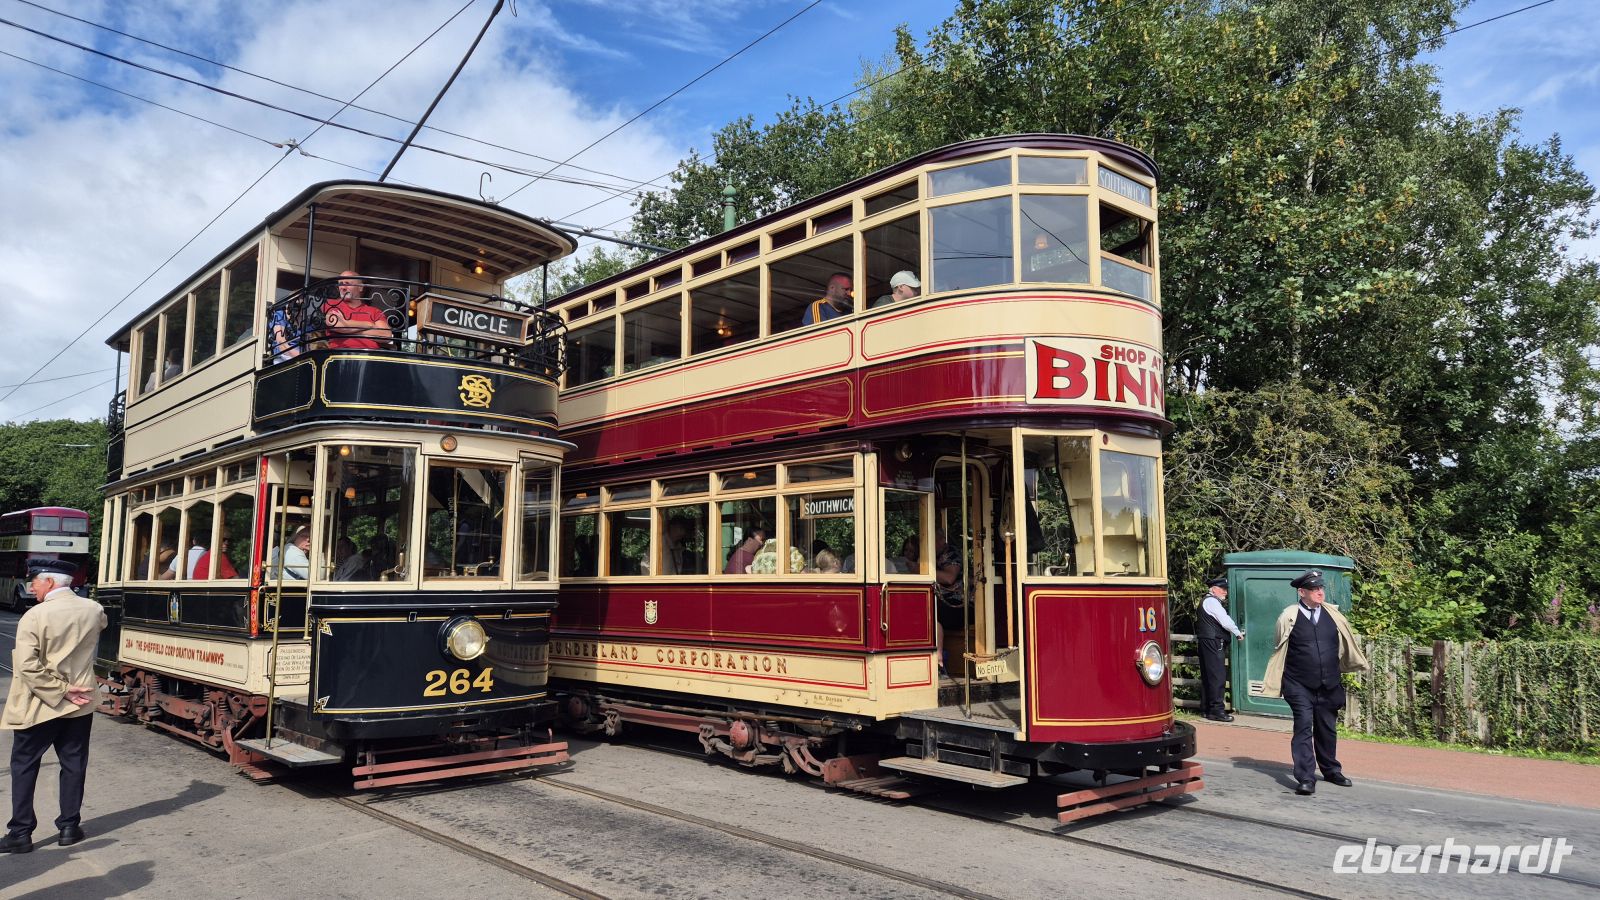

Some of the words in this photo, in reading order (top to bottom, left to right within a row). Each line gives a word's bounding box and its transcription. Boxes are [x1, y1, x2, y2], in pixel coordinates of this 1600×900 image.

[1099, 170, 1147, 205] SOUTHWICK
[444, 307, 508, 335] CIRCLE
[1100, 344, 1146, 365] SHOP
[804, 498, 855, 515] SOUTHWICK
[1138, 606, 1157, 632] 16
[143, 641, 164, 656] SHEFFIELD
[164, 645, 195, 661] CORPORATION
[196, 649, 224, 666] TRAMWAYS
[656, 648, 788, 674] CORPORATION
[423, 667, 494, 697] 264
[977, 665, 986, 675] No
[986, 664, 1005, 674] Entry
